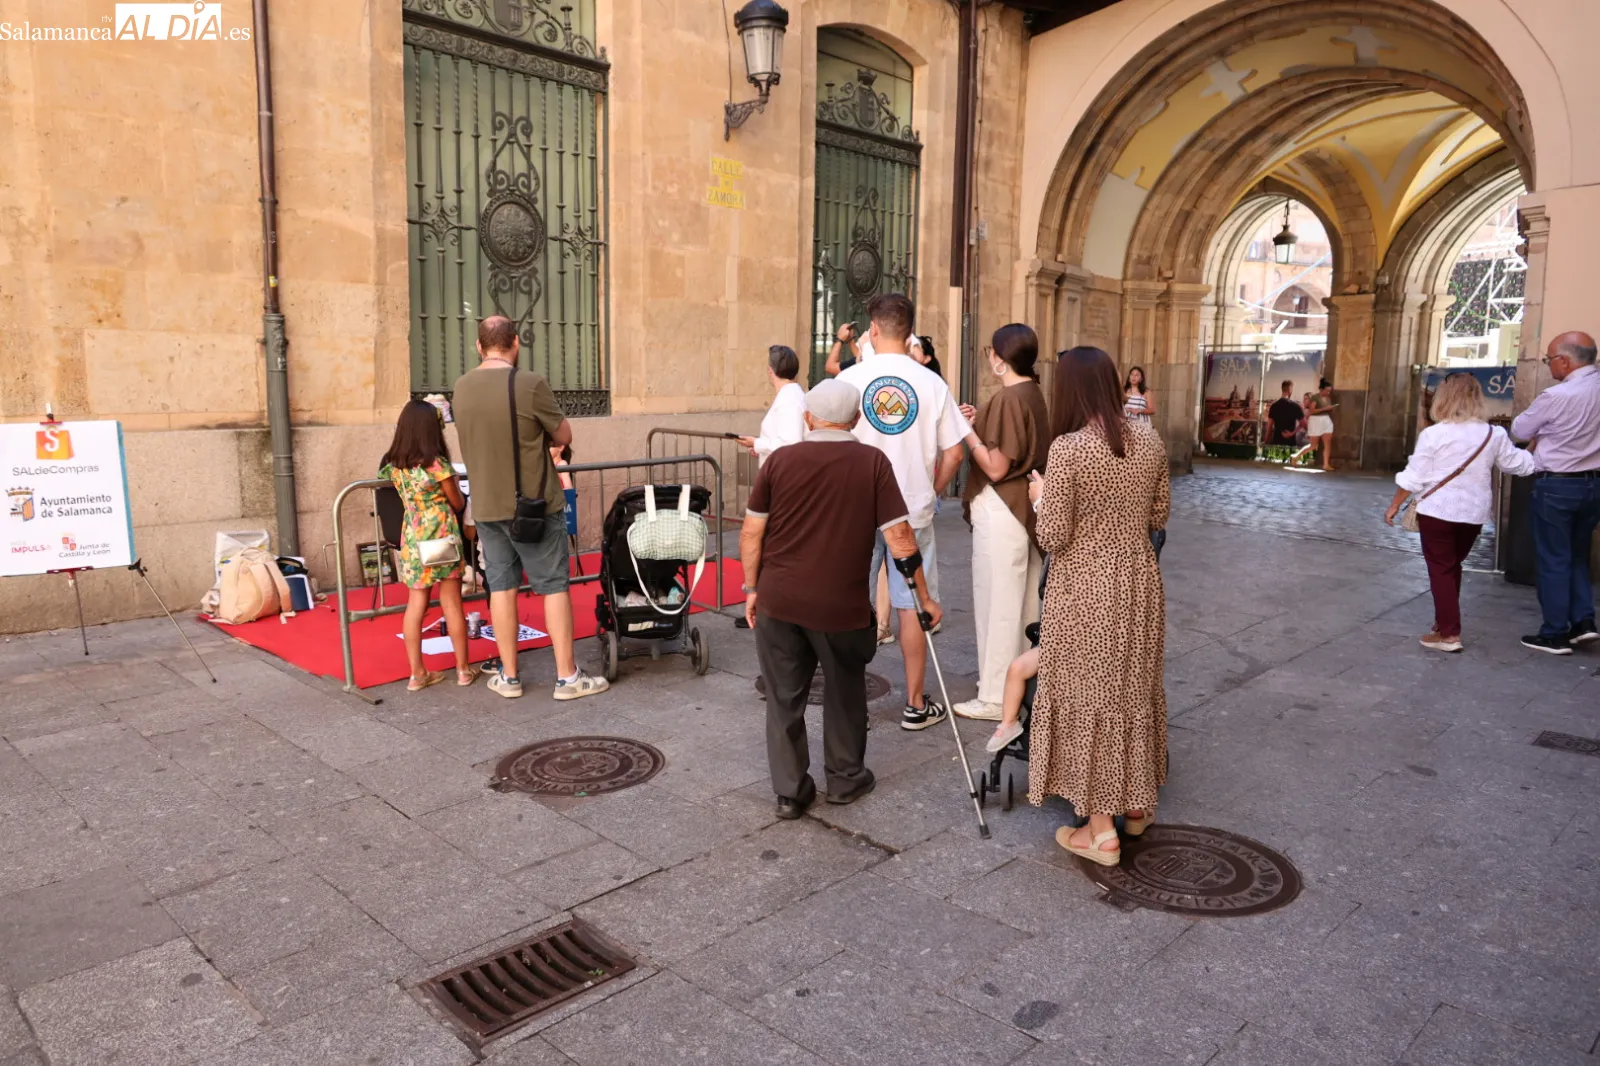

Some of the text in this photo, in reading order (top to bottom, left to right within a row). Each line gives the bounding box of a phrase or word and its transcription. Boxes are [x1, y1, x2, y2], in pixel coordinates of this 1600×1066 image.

[708, 189, 745, 207] ZAMORA
[1220, 358, 1252, 372] SALA
[865, 378, 917, 404] CONVERSE
[12, 464, 100, 477] SALdeCompras
[40, 493, 112, 508] Ayuntamiento
[40, 505, 113, 518] de Salamanca
[78, 543, 100, 551] Junta
